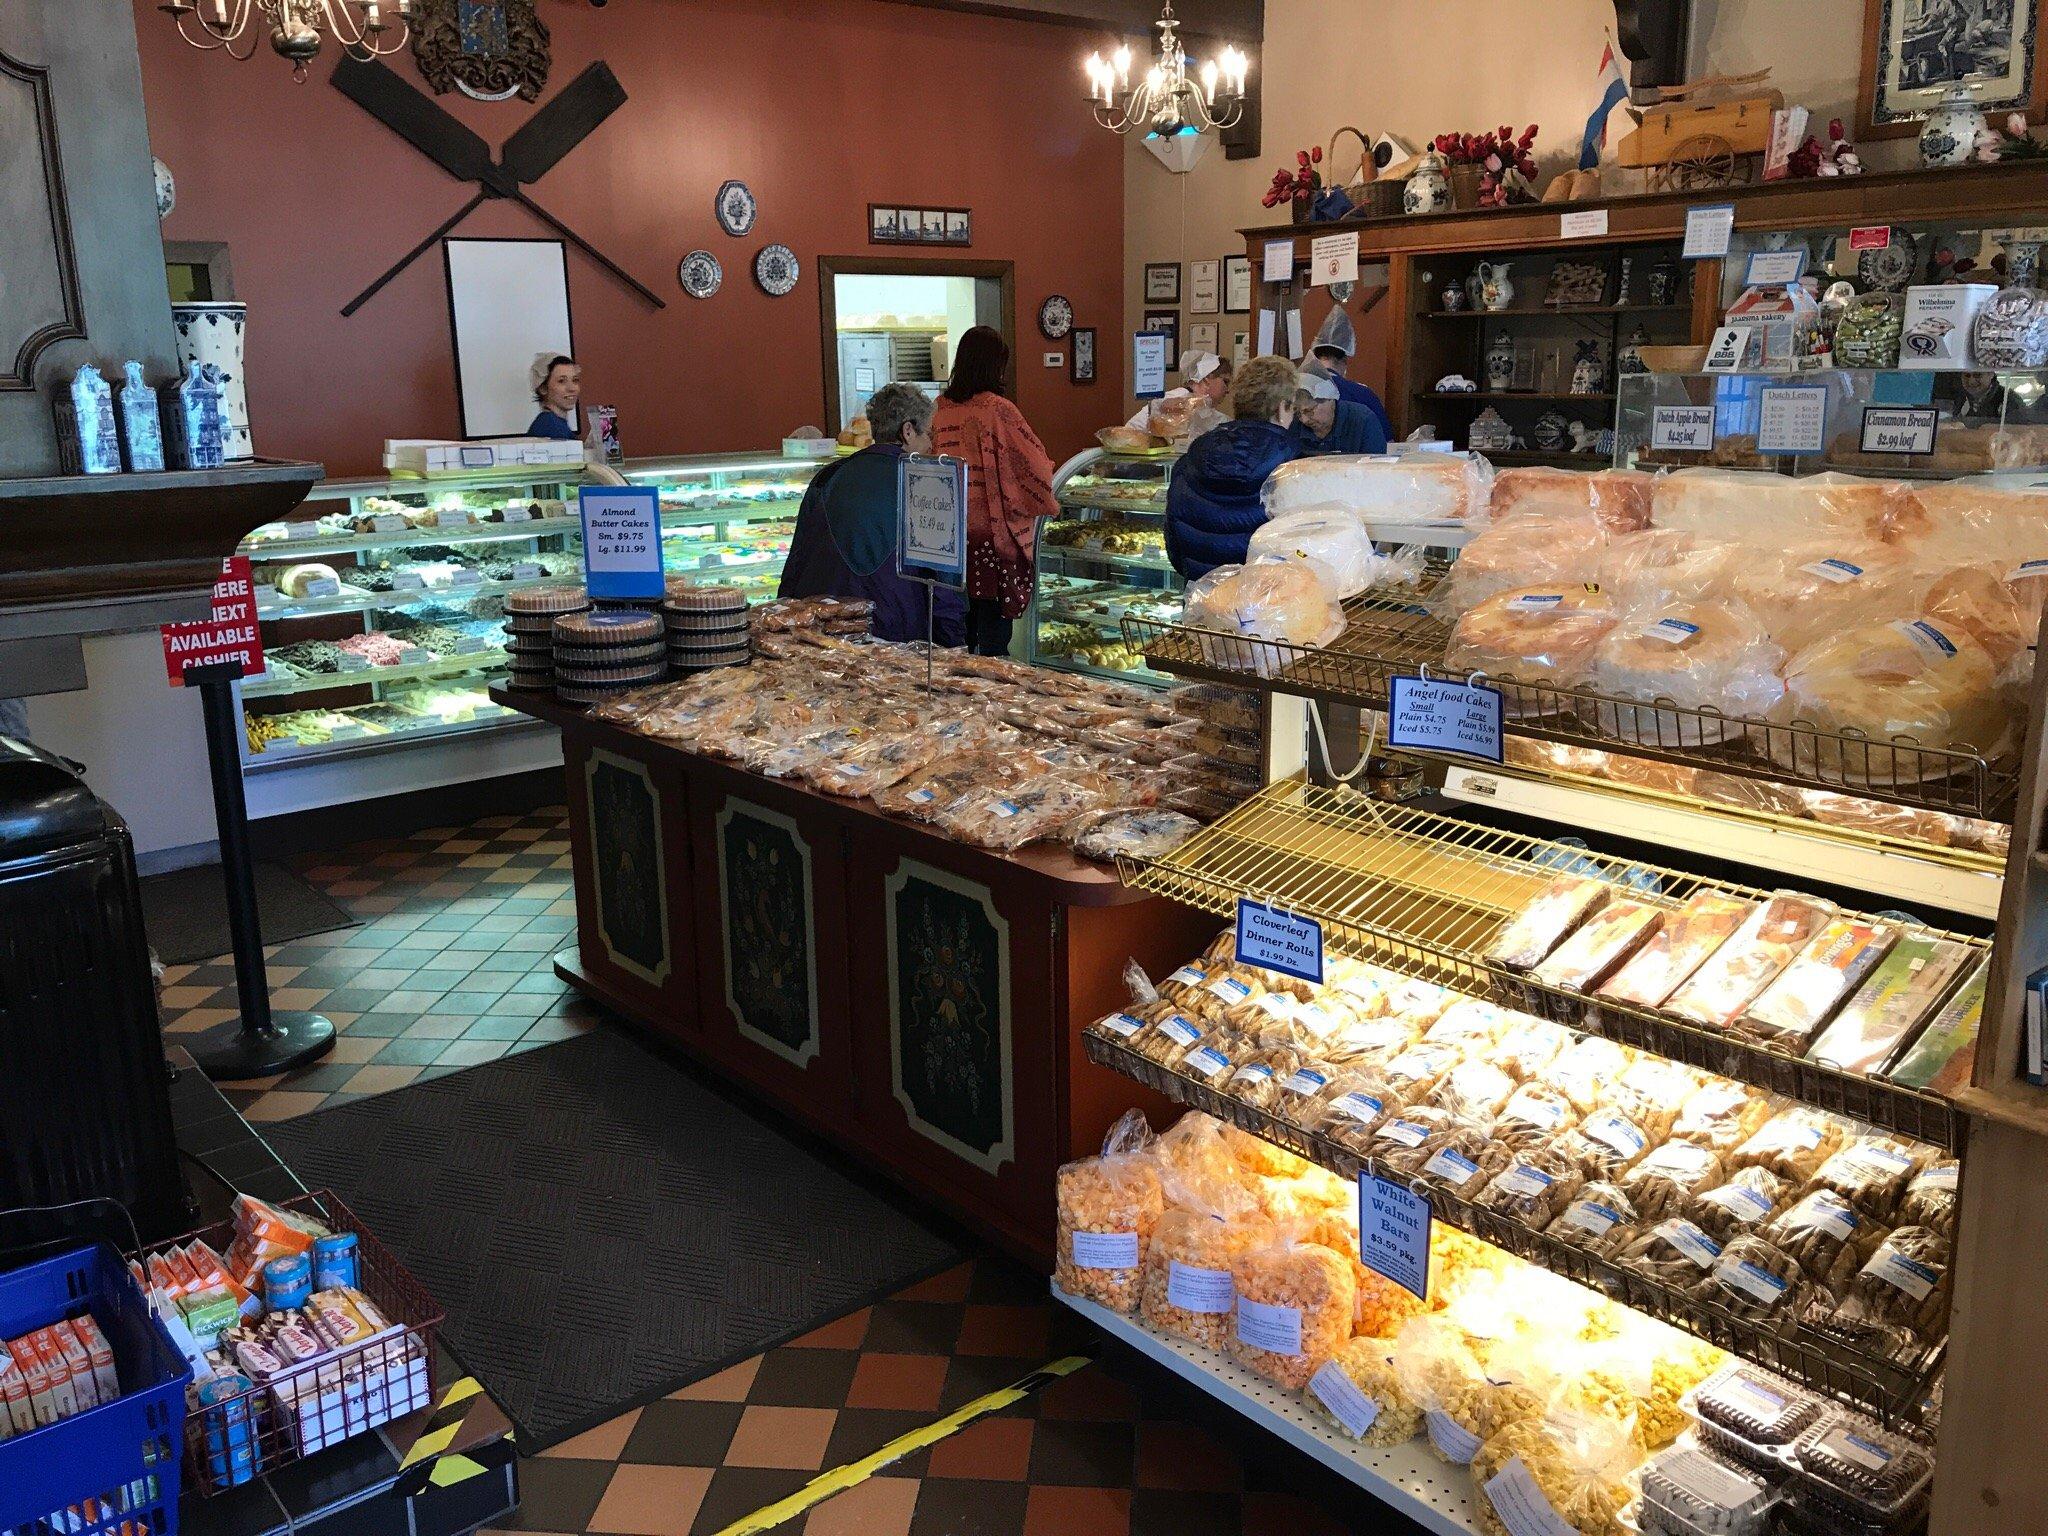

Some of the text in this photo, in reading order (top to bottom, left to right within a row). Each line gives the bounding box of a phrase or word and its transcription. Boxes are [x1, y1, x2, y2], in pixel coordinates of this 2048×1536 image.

[1714, 350, 1735, 359] BBB
[1768, 390, 1818, 400] Dutch Letters
[1657, 411, 1710, 427] Dutch Apple Bread
[1867, 412, 1933, 427] Cinnamon Bread
[1684, 429, 1697, 445] loaf
[1877, 432, 1917, 450] $2.99 loaf
[912, 495, 952, 511] Coffee Cakes
[601, 507, 636, 516] Almond
[591, 519, 650, 528] Butter Cakes
[598, 532, 644, 541] Sm. $9.75
[598, 544, 646, 554] Lg. $11.99
[170, 626, 256, 653] AVAILABLE
[1405, 687, 1492, 710] Angel food Cakes
[1410, 701, 1435, 712] Small
[1399, 712, 1447, 724] Plain $4.75
[1466, 709, 1487, 721] Large
[1398, 724, 1442, 735] Iced $5.75
[1457, 719, 1496, 735] Plain $5.99
[1457, 731, 1493, 745] Iced $6.99
[1252, 914, 1310, 940] Cloverleaf
[1245, 930, 1315, 957] Dinner Rolls
[1259, 949, 1299, 967] $1.99 Dz.
[1375, 1181, 1416, 1210] White
[1371, 1197, 1420, 1230] Walnut
[1381, 1218, 1410, 1243] Bars
[1370, 1233, 1417, 1265] $3.59 pkg.
[193, 1316, 234, 1335] PICKWICK
[324, 1309, 356, 1335] Verkade
[283, 1327, 314, 1354] Verkade
